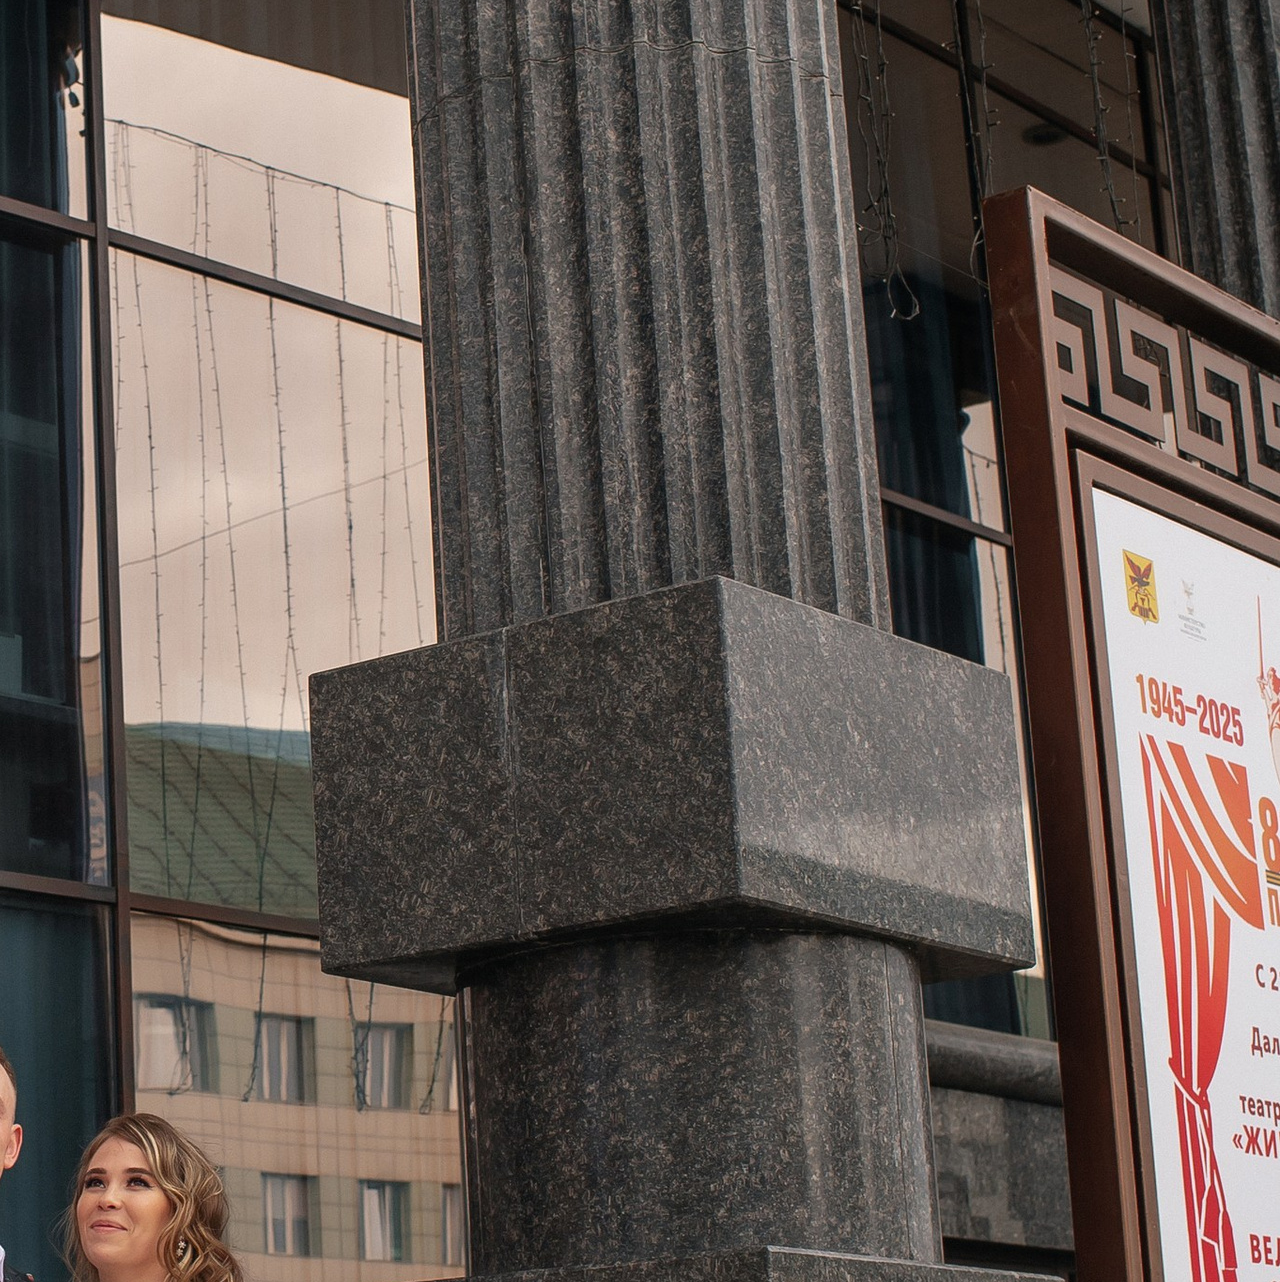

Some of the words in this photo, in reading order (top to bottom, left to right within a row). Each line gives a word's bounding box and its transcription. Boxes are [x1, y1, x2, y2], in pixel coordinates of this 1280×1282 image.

[1255, 963, 1266, 988] С
[1269, 966, 1280, 991] 2
[1232, 1124, 1280, 1159] «ЖИ
